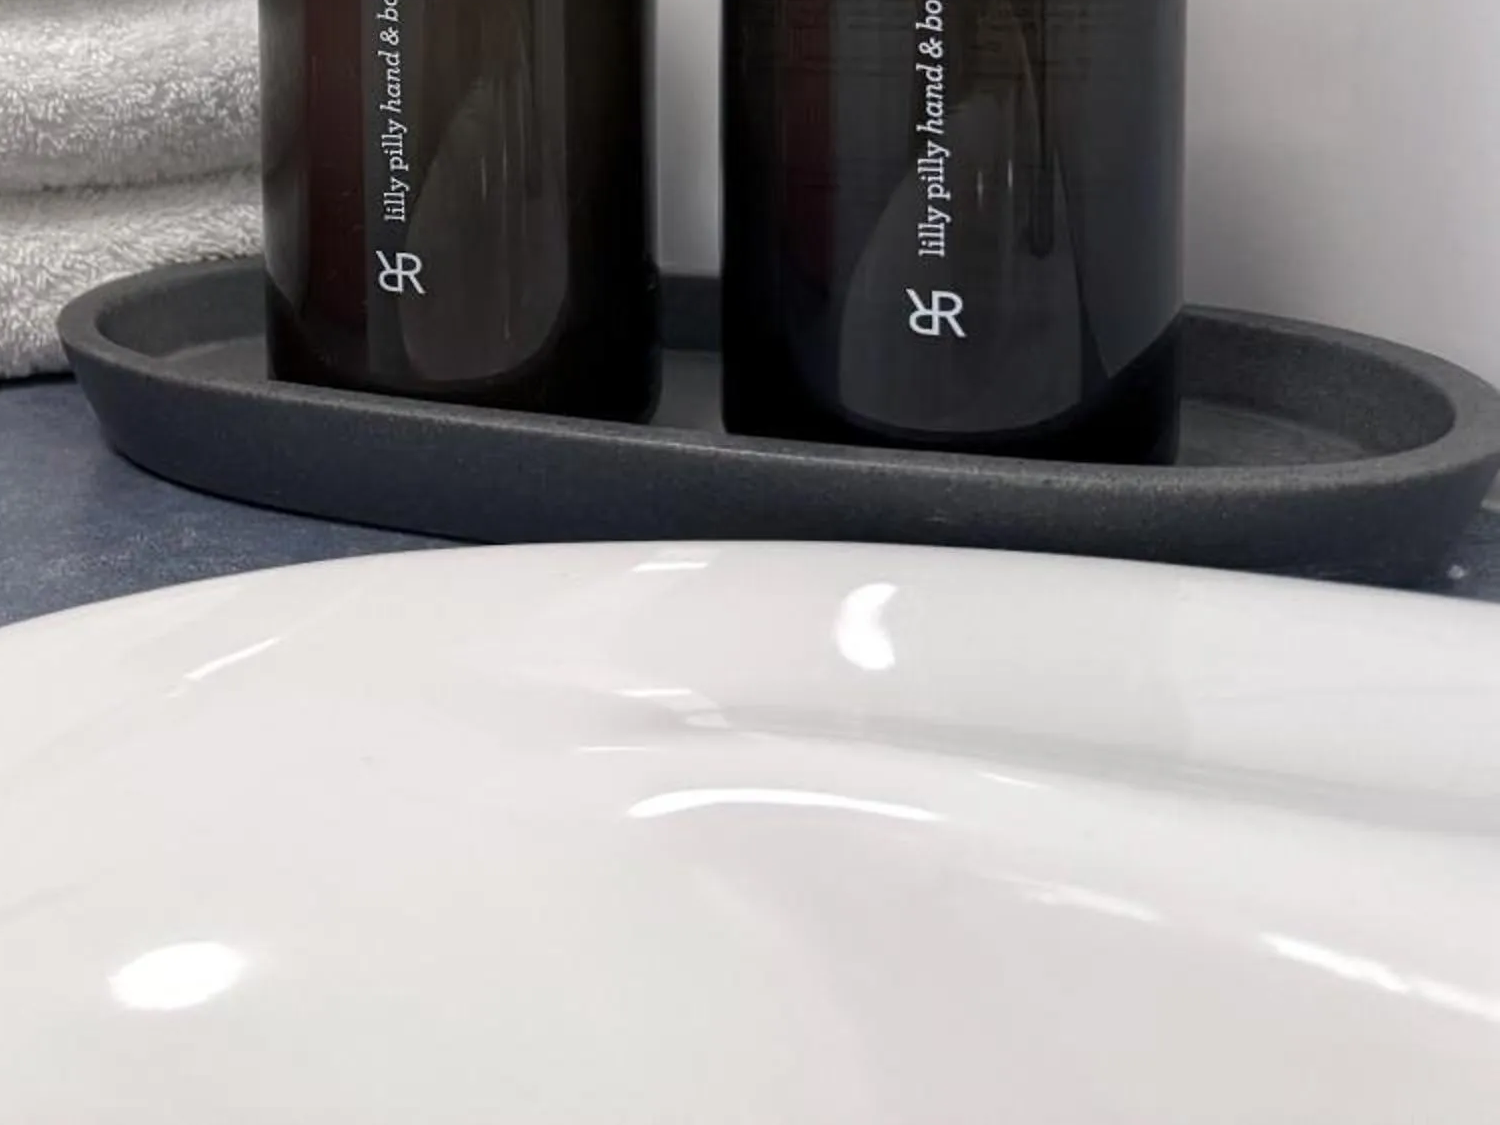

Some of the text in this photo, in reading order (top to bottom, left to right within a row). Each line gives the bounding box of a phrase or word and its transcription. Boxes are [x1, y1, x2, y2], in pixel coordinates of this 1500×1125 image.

[379, 26, 400, 46] &
[918, 37, 944, 59] &
[377, 49, 402, 115] hand
[915, 62, 945, 135] hand
[380, 118, 409, 172] pilly
[917, 139, 952, 201] pilly
[382, 175, 410, 223] lilly
[917, 204, 952, 258] lilly
